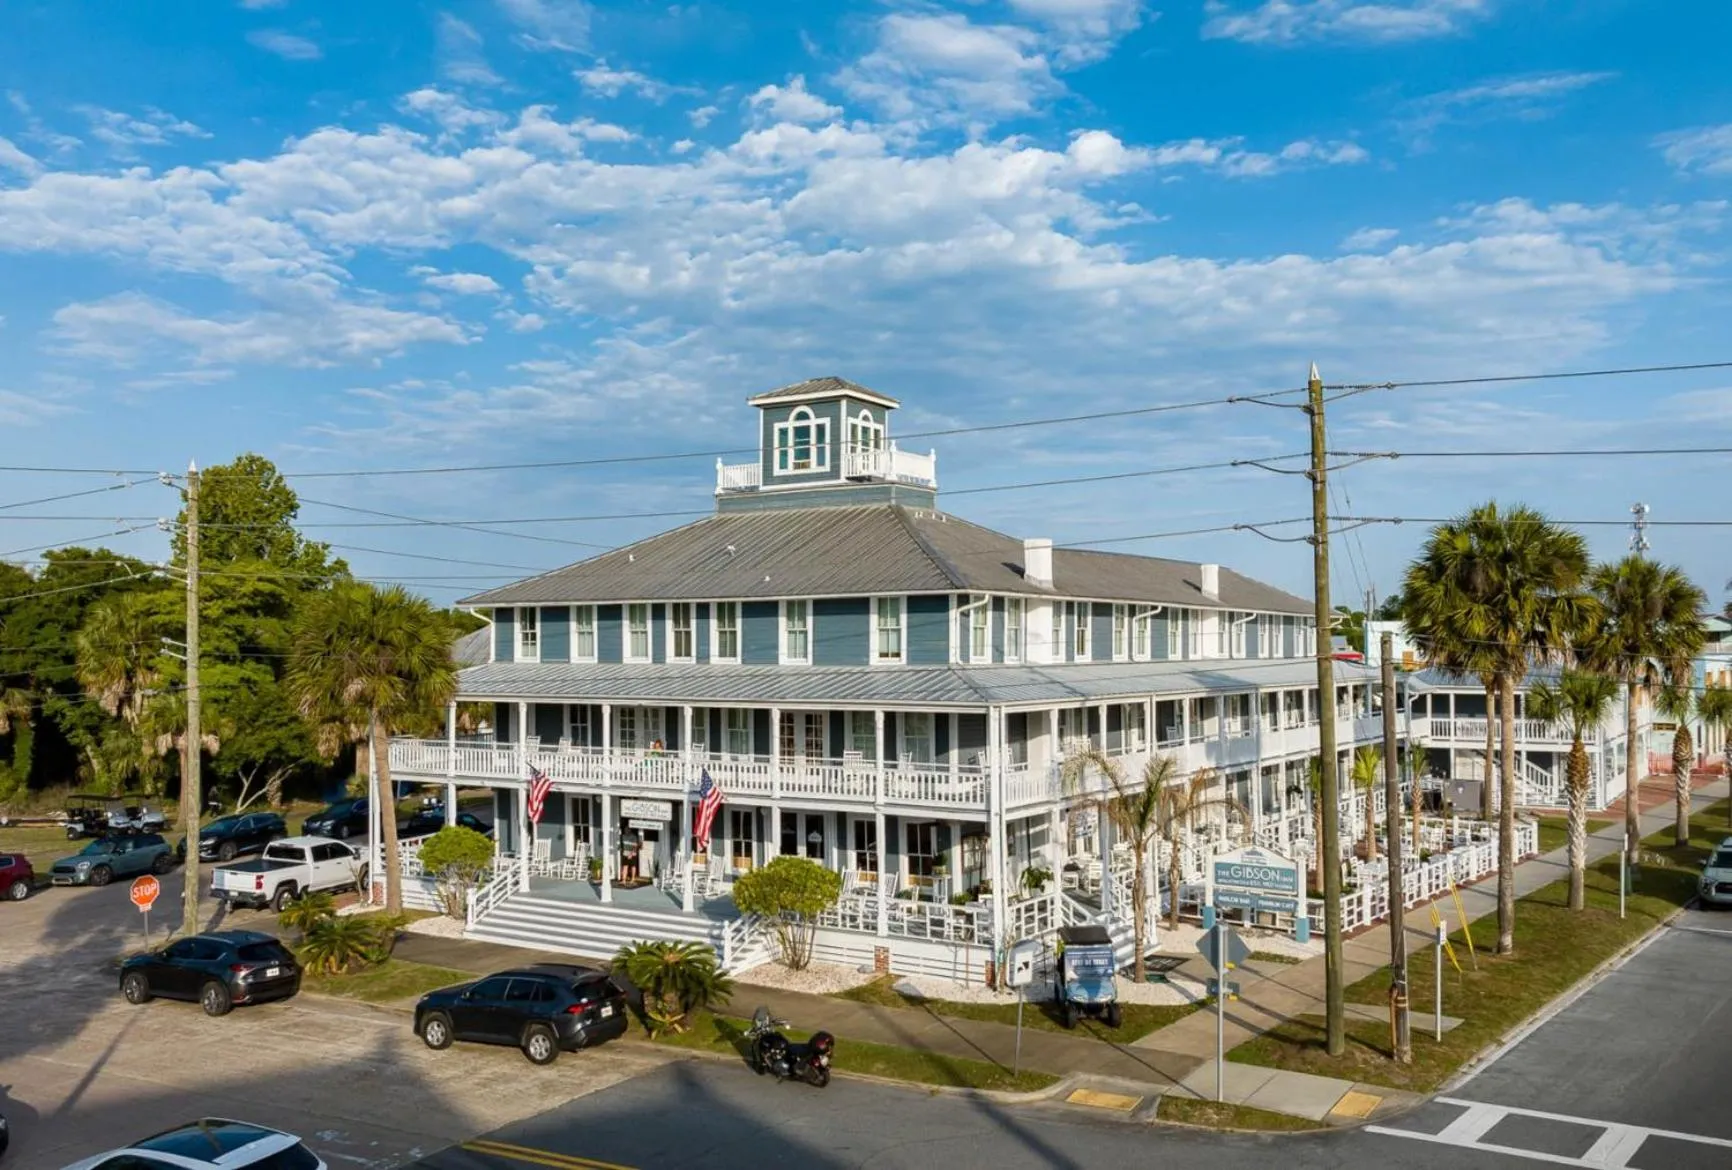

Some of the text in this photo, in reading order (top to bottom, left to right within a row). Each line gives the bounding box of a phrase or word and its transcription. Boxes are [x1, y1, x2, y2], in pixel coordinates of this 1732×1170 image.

[1217, 869, 1230, 877] THE
[1230, 865, 1280, 881] GIBSON
[133, 883, 156, 898] STOP
